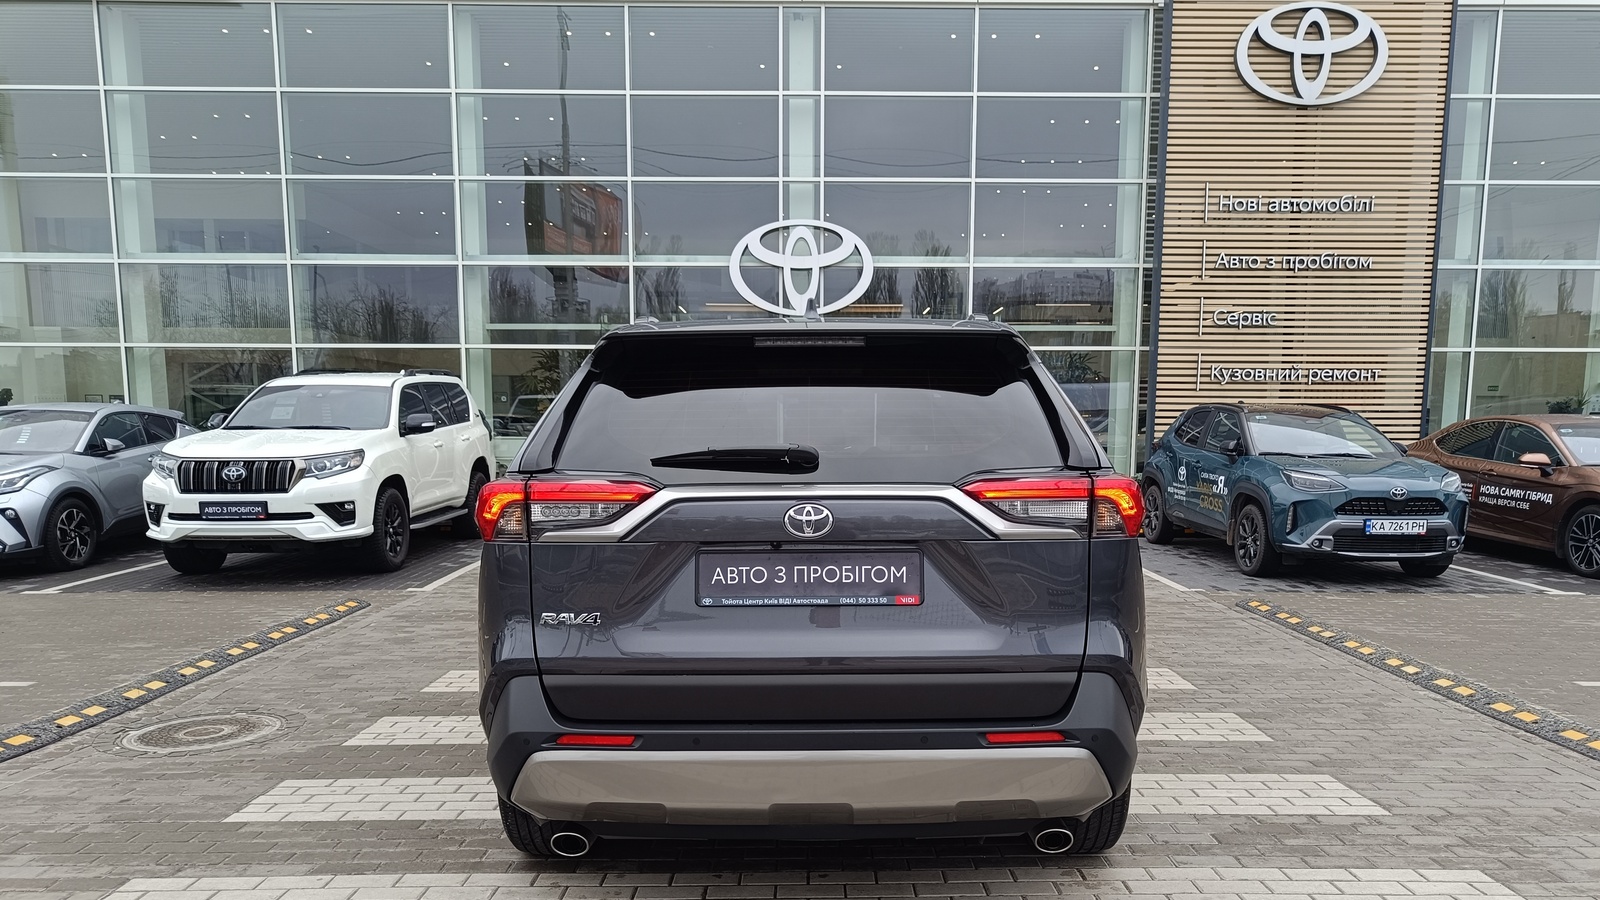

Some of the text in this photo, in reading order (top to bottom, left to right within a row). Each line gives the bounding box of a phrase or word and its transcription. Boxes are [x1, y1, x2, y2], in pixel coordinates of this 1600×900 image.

[1218, 194, 1376, 212] Нові автомобілі
[1214, 252, 1373, 274] Авто з пробігом
[1212, 308, 1278, 330] Сервіс
[1210, 363, 1382, 385] Кузовний ремонт
[1200, 495, 1223, 512] CROSS
[1480, 484, 1499, 496] НОВА
[1500, 487, 1526, 499] CAMRY
[1525, 490, 1553, 505] ГІБРИД
[1516, 501, 1530, 510] СЕБЕ
[1388, 521, 1409, 531] 7261
[711, 565, 907, 584] АВТО З ПРОБІГОМ
[743, 598, 763, 606] Центр
[764, 597, 778, 605] Київ
[839, 597, 856, 605] (044)
[539, 612, 601, 626] RAV4
